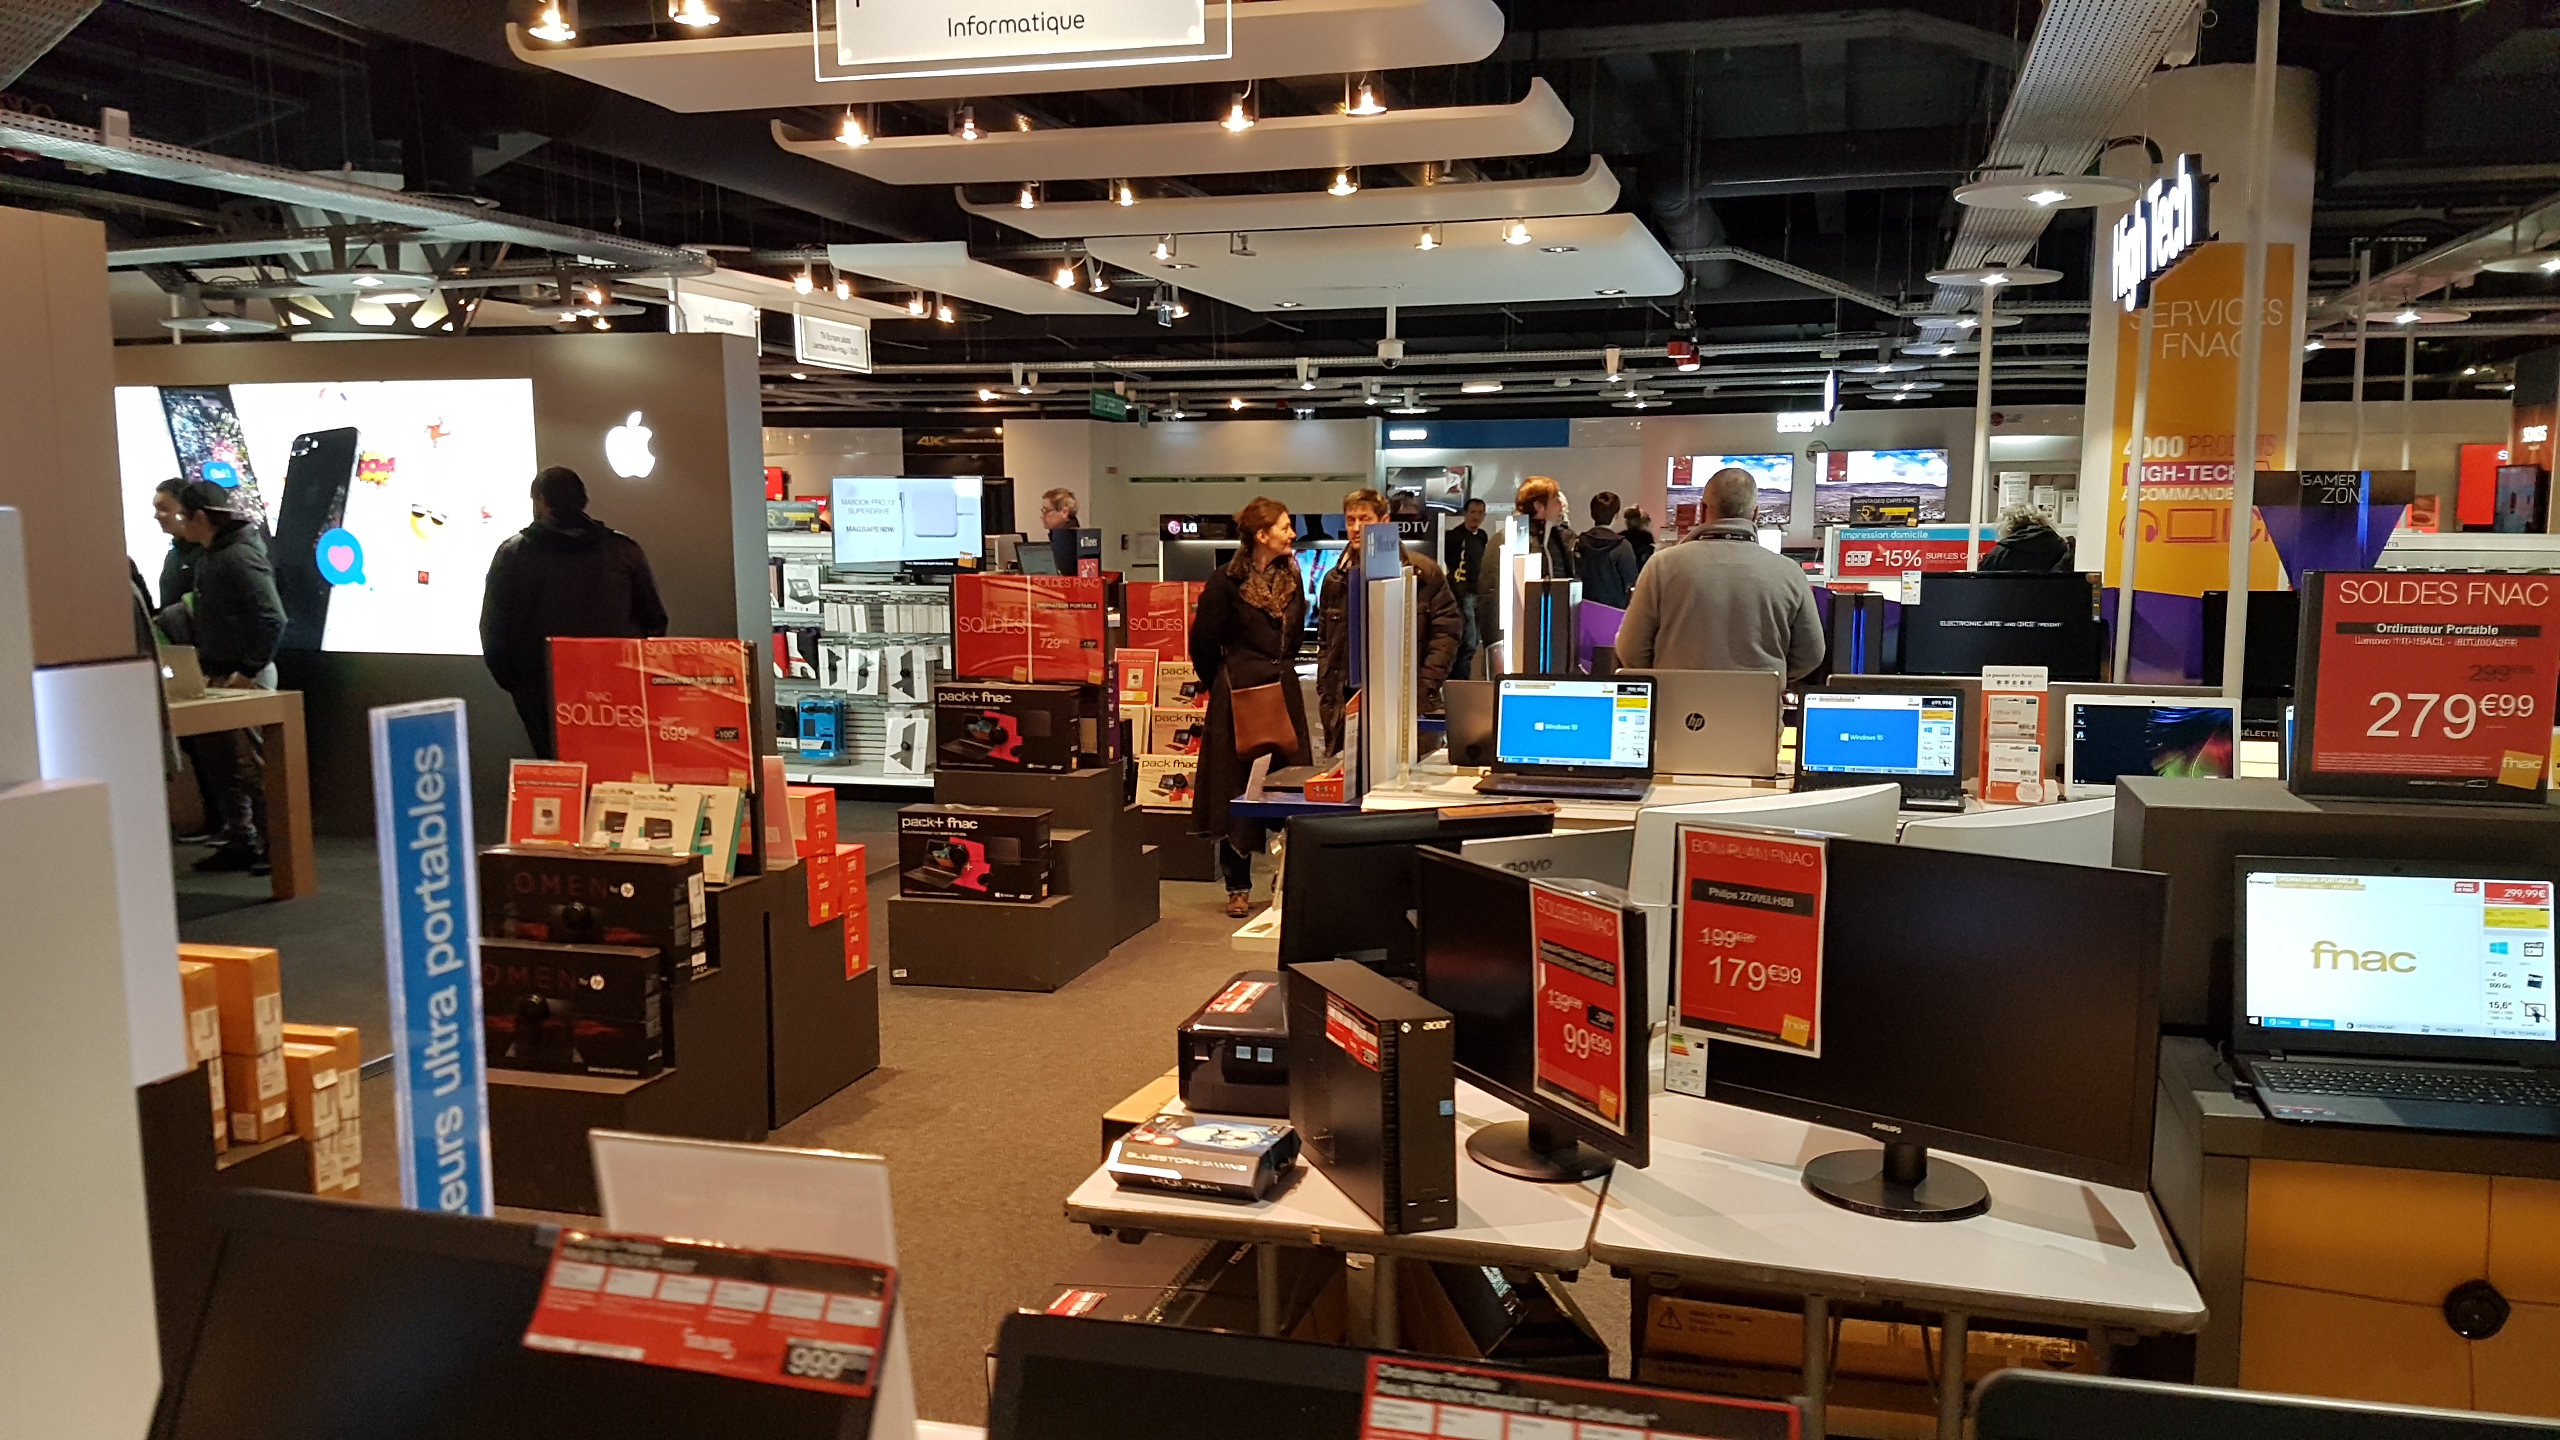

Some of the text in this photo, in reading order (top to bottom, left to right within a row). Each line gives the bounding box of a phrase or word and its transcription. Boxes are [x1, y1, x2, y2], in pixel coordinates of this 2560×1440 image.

[947, 11, 1085, 37] Informatique
[2112, 152, 2193, 312] High Tech
[2130, 298, 2284, 330] ERVICS
[917, 435, 946, 447] 4K
[2300, 474, 2356, 486] GAMER
[2320, 487, 2362, 504] ZON
[1182, 522, 1198, 533] LG
[1841, 530, 1929, 540] Impression domicile
[1875, 549, 1922, 567] -15%
[2339, 580, 2549, 607] SOLDES FNAC
[958, 616, 1027, 635] SOLDES
[1129, 618, 1183, 632] SOLDES
[2376, 623, 2499, 635] Ordinateur Portable
[1161, 666, 1189, 680] pack
[938, 691, 1012, 705] pack+ fnac
[556, 703, 645, 728] SOLDES
[1154, 713, 1205, 725] pack fna
[1686, 713, 1705, 731] hp
[1141, 759, 1171, 770] pack
[2502, 756, 2543, 770] fnac
[901, 817, 978, 830] pack+ fnac
[407, 742, 464, 982] portables
[1504, 859, 1552, 873] novo
[1708, 887, 1738, 900] Philips
[2503, 888, 2547, 899] 299,99€
[2311, 940, 2417, 973] fnac
[1422, 1019, 1451, 1031] acer
[422, 985, 464, 1098] ultra
[437, 1105, 471, 1215] eurs
